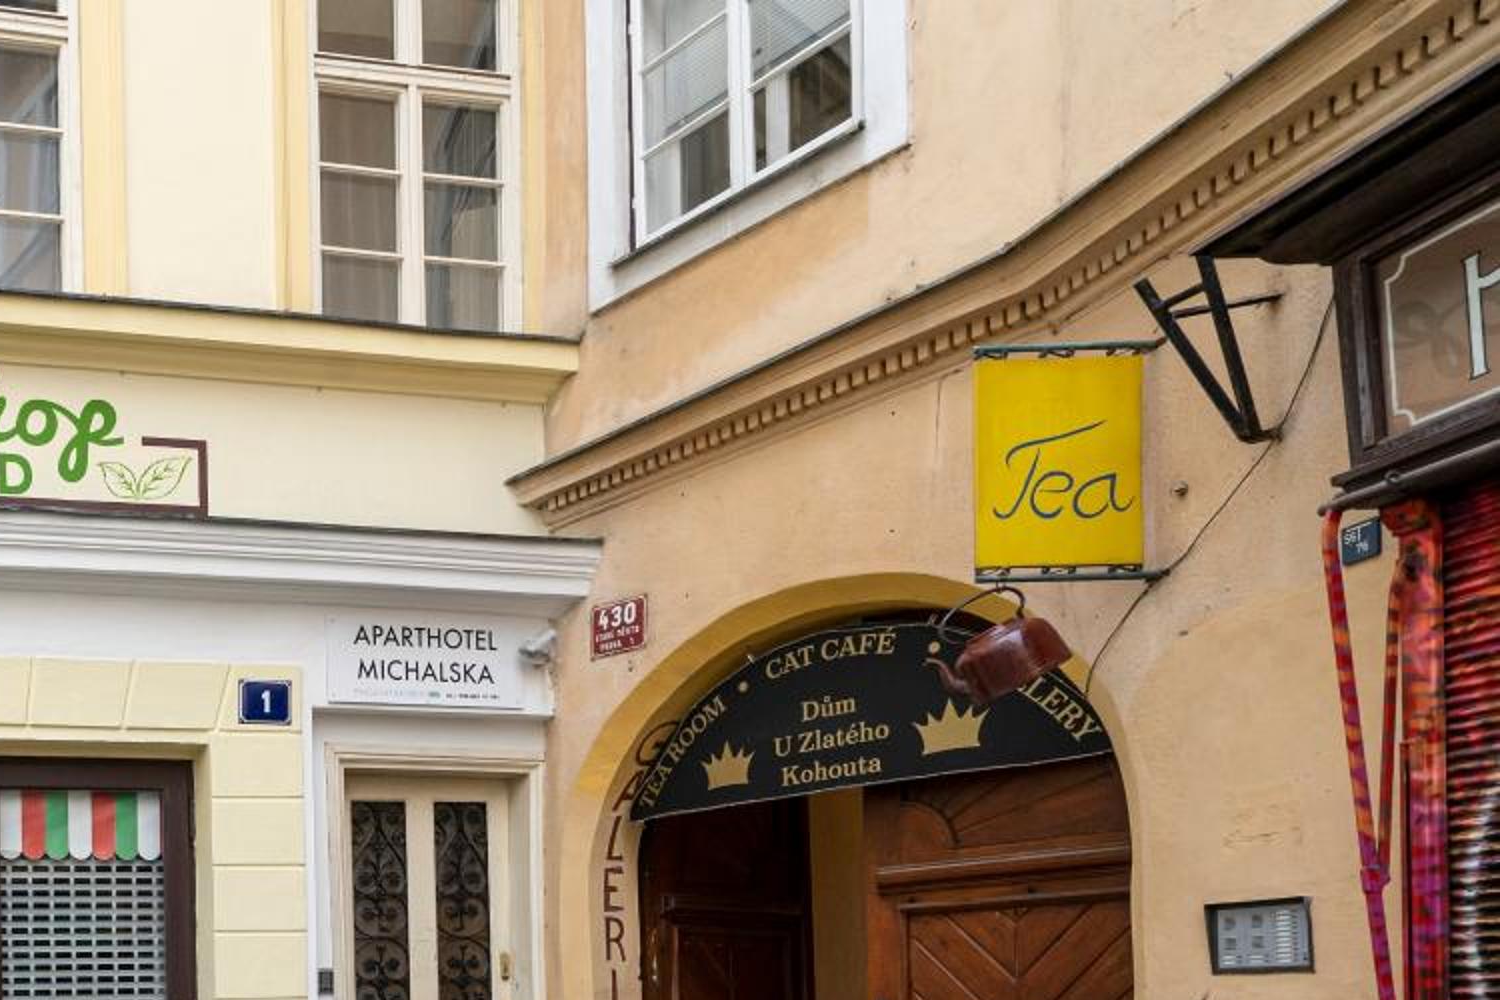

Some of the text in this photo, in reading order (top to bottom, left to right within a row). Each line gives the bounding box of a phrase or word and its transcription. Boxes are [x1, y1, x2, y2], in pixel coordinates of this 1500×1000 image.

[992, 419, 1135, 520] Tea
[598, 602, 637, 630] 430
[353, 624, 498, 651] APARTHOTEL
[357, 660, 495, 686] MICHALSKA
[260, 690, 271, 713] 1
[801, 695, 857, 722] Dům
[639, 765, 673, 807] TEA
[667, 695, 727, 763] ROOM
[765, 645, 815, 680] CAT
[820, 626, 896, 661] CAFÉ
[773, 721, 891, 757] U Zlatého
[781, 755, 882, 787] Kohouta
